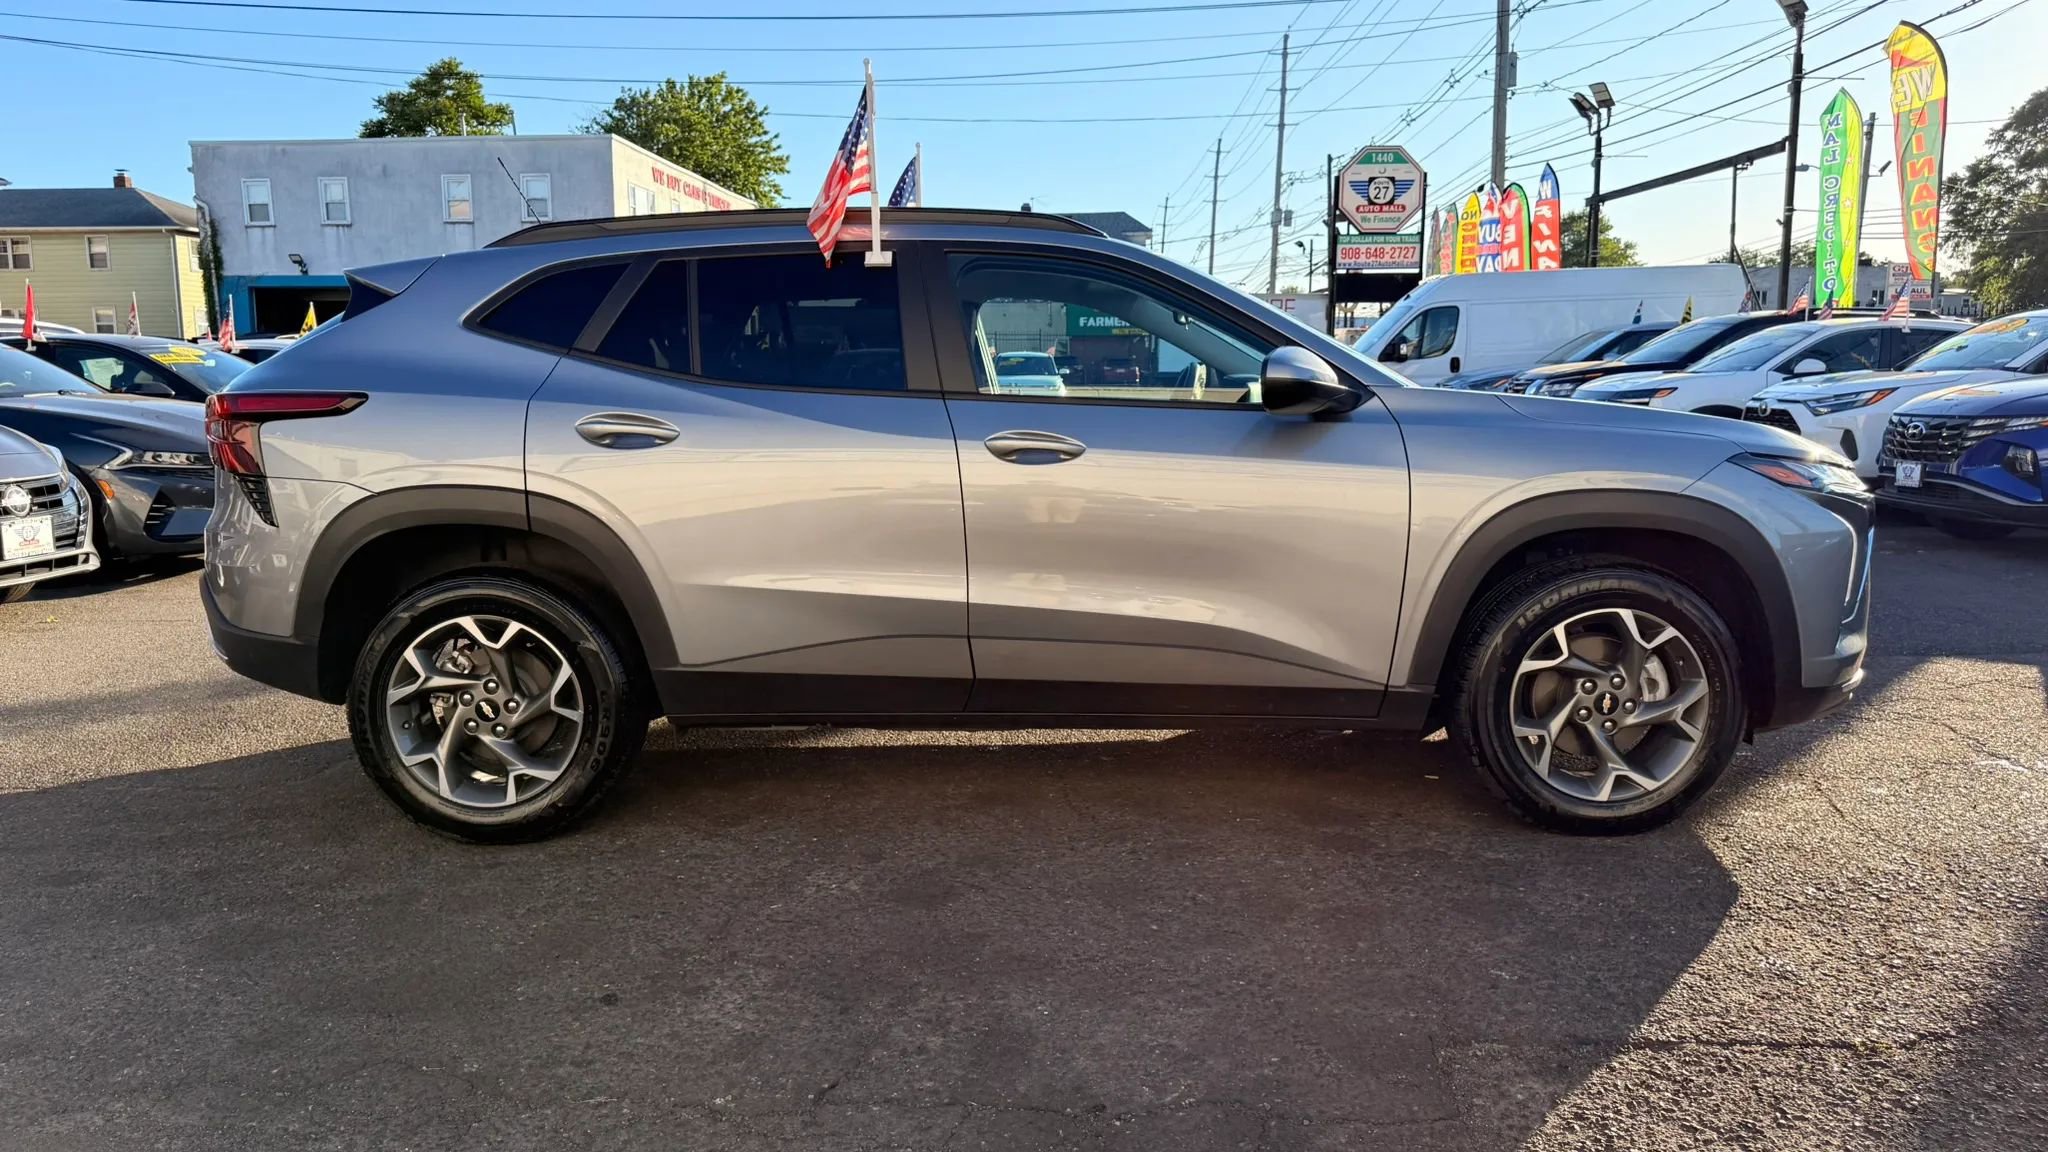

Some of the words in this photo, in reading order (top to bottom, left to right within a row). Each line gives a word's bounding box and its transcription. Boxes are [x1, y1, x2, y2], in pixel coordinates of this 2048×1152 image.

[1371, 152, 1394, 163] 1440
[1373, 186, 1390, 200] 27
[1373, 215, 1402, 223] Finance
[1351, 235, 1373, 243] DOLLAR
[1373, 235, 1385, 243] FOR
[1341, 246, 1417, 260] 908-648-2727
